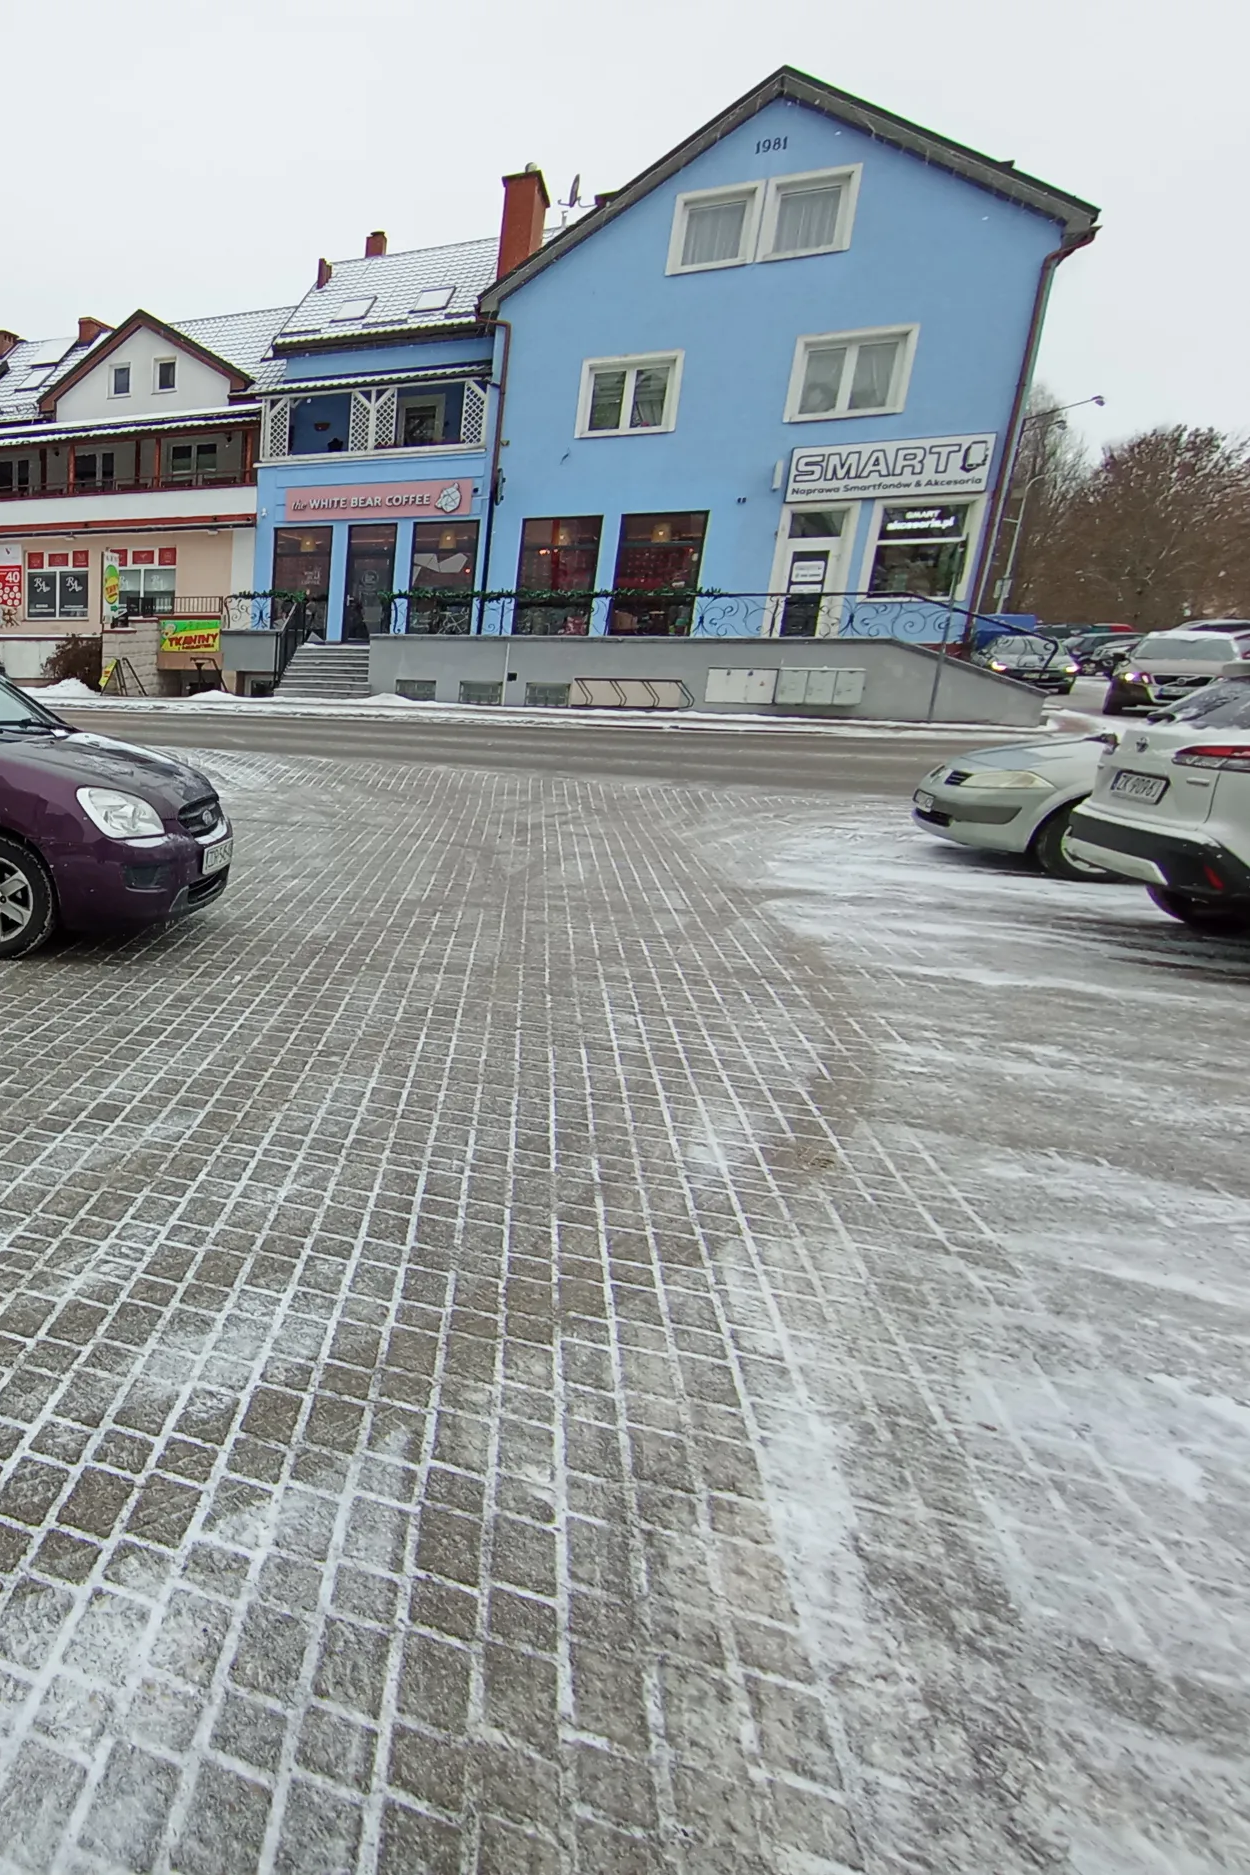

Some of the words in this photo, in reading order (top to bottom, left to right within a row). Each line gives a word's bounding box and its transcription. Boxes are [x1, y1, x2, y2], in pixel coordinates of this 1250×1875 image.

[754, 136, 788, 155] 1981
[793, 443, 962, 483] SMART
[791, 486, 840, 496] Naprawa
[843, 480, 912, 493] Smartfonów
[924, 476, 983, 487] Akcesoria
[291, 499, 307, 511] the
[309, 497, 348, 510] WHITE
[350, 495, 382, 508] BEAR
[385, 493, 431, 507] COFFEE
[5, 571, 20, 583] 40
[168, 633, 219, 648] TKANINY
